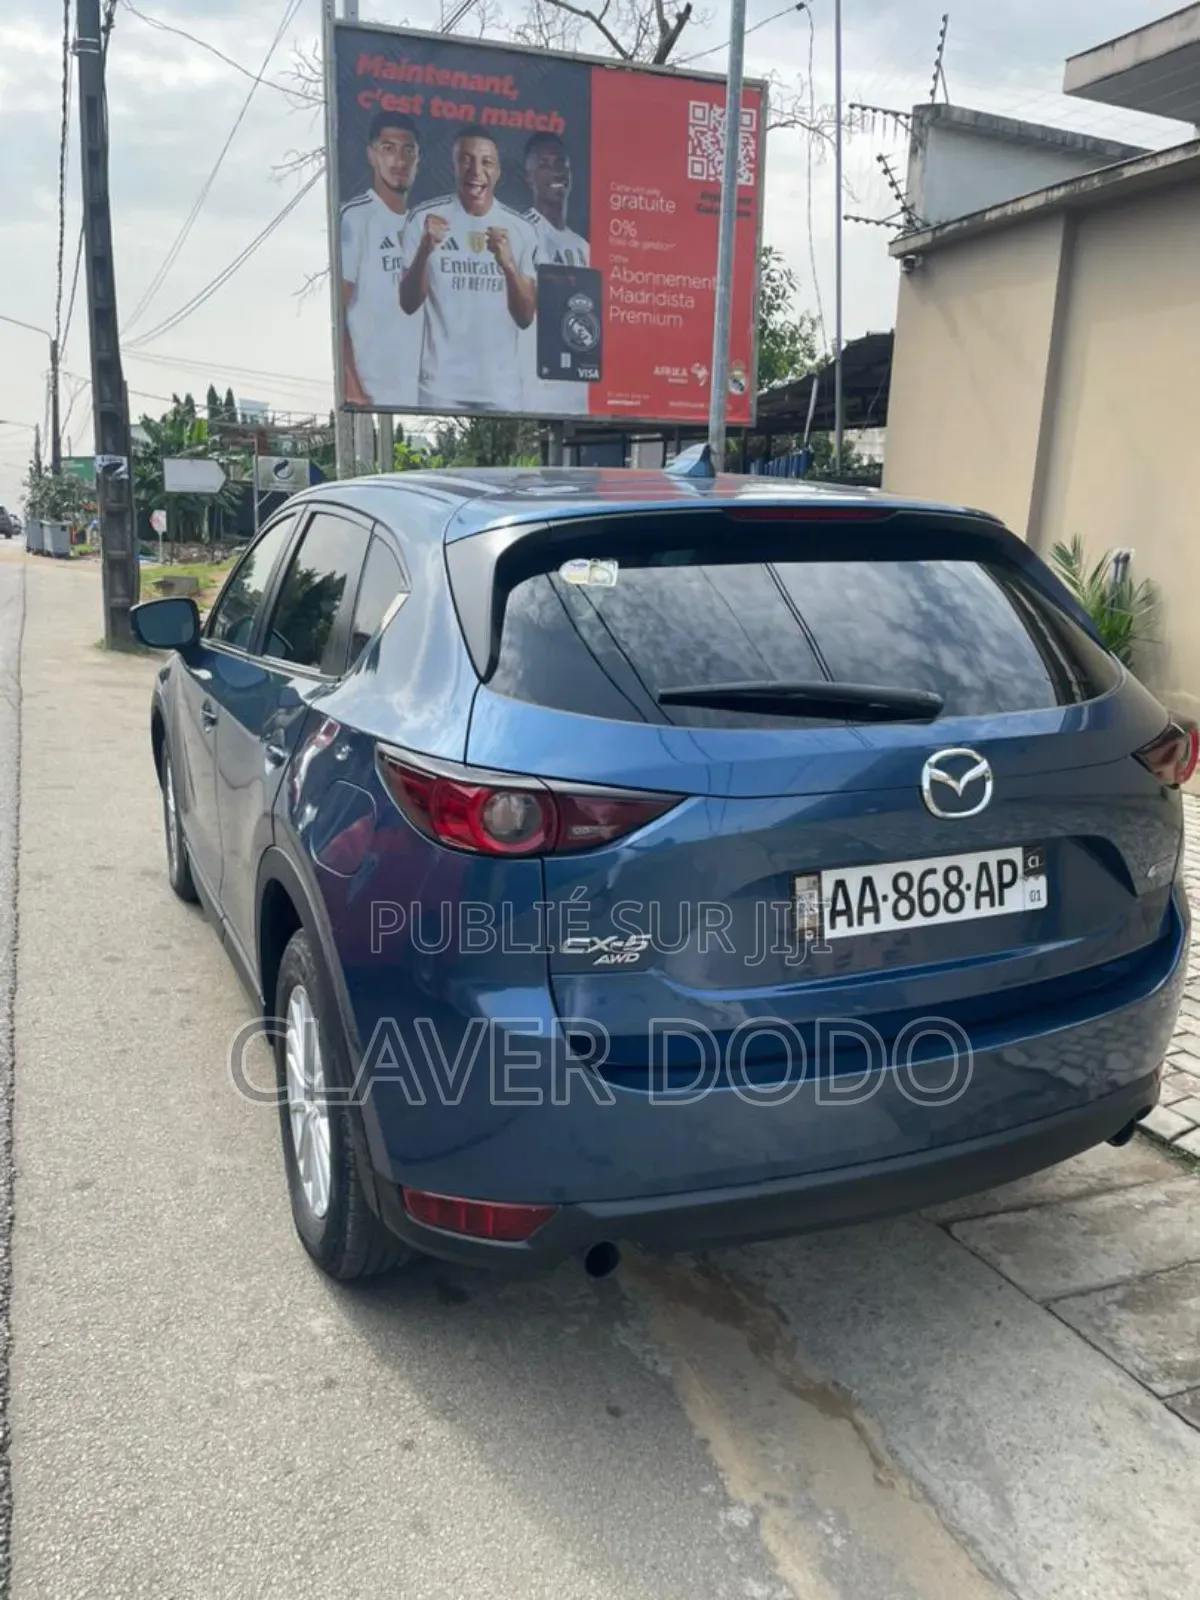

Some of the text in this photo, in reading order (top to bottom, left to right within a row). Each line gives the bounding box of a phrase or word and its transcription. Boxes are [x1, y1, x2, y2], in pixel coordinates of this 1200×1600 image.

[357, 53, 518, 100] Maintenant,
[357, 88, 566, 136] c'est ton match
[610, 193, 676, 214] gratuite
[609, 218, 637, 237] 0%
[610, 265, 718, 291] Abonnement
[609, 285, 695, 309] Madridista
[609, 304, 683, 328] Premium
[578, 368, 599, 379] VISA
[560, 934, 653, 954] CX-5
[592, 952, 640, 966] AWD
